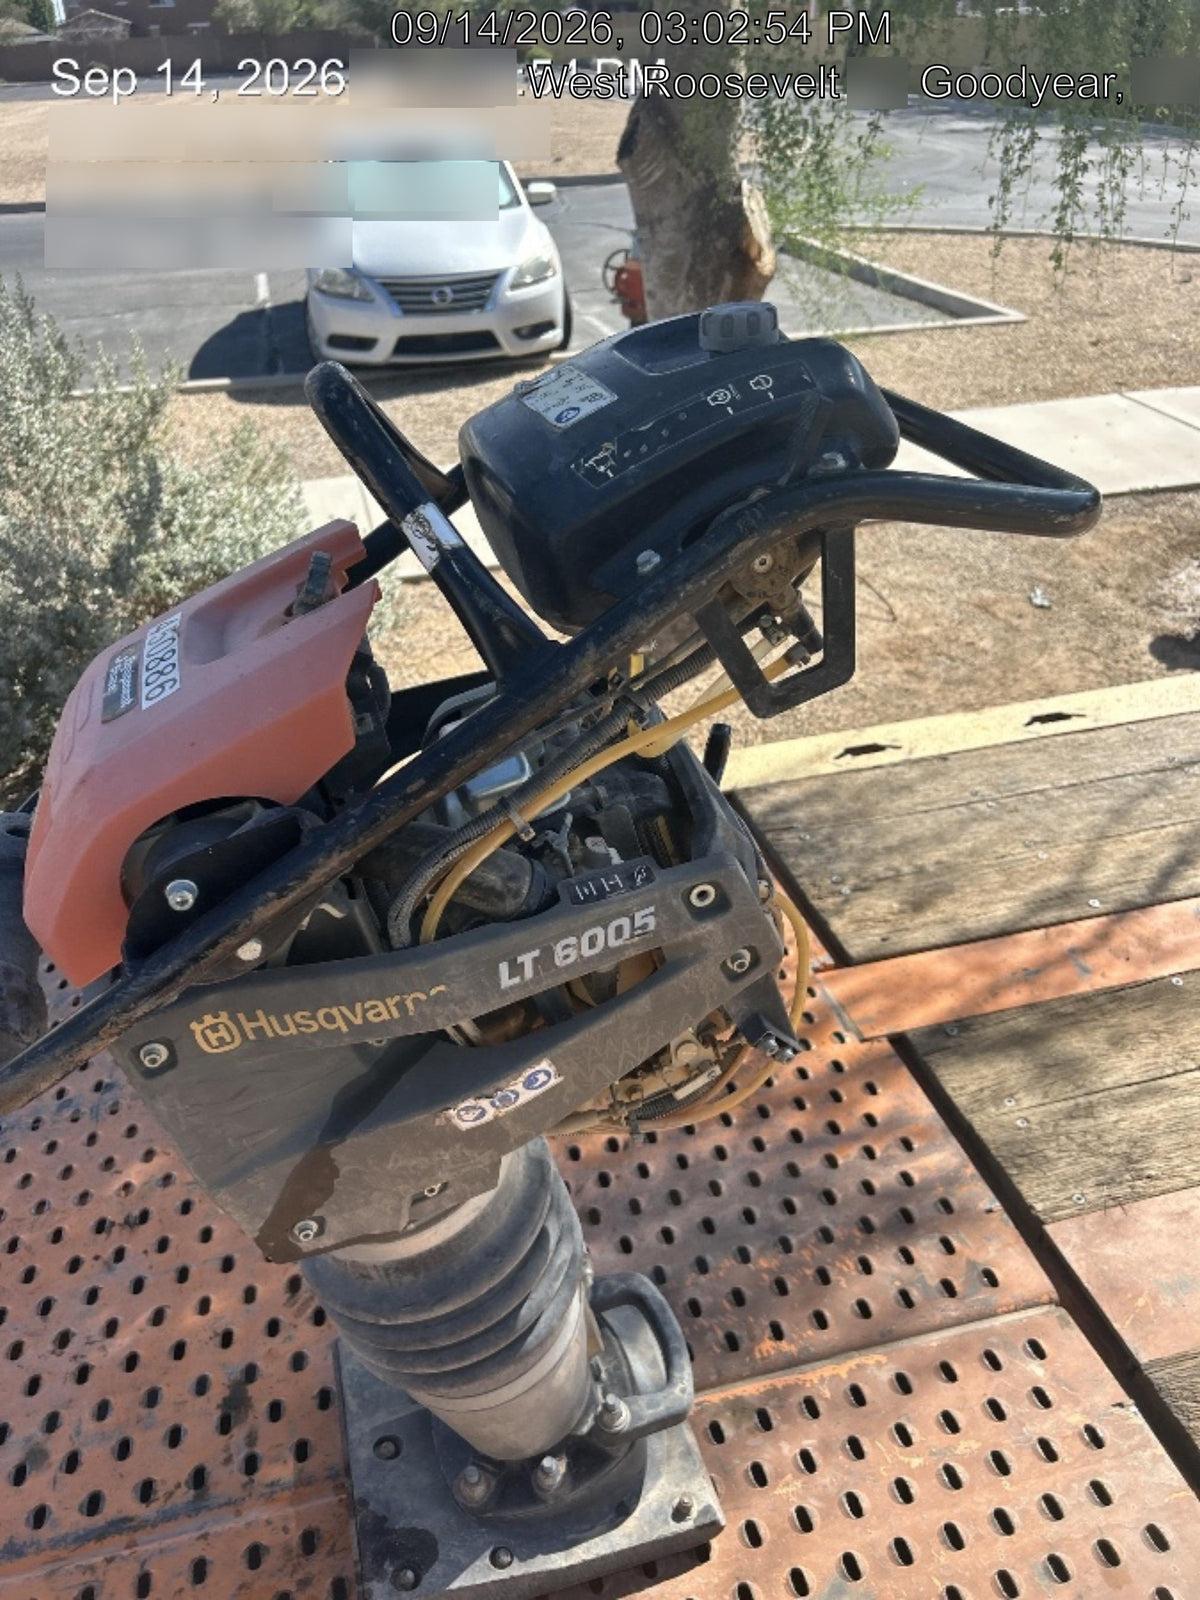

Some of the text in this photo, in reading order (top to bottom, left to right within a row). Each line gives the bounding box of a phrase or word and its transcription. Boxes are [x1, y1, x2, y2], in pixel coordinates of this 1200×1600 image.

[497, 906, 658, 990] LT 6005
[237, 984, 446, 1042] Husqvarn
